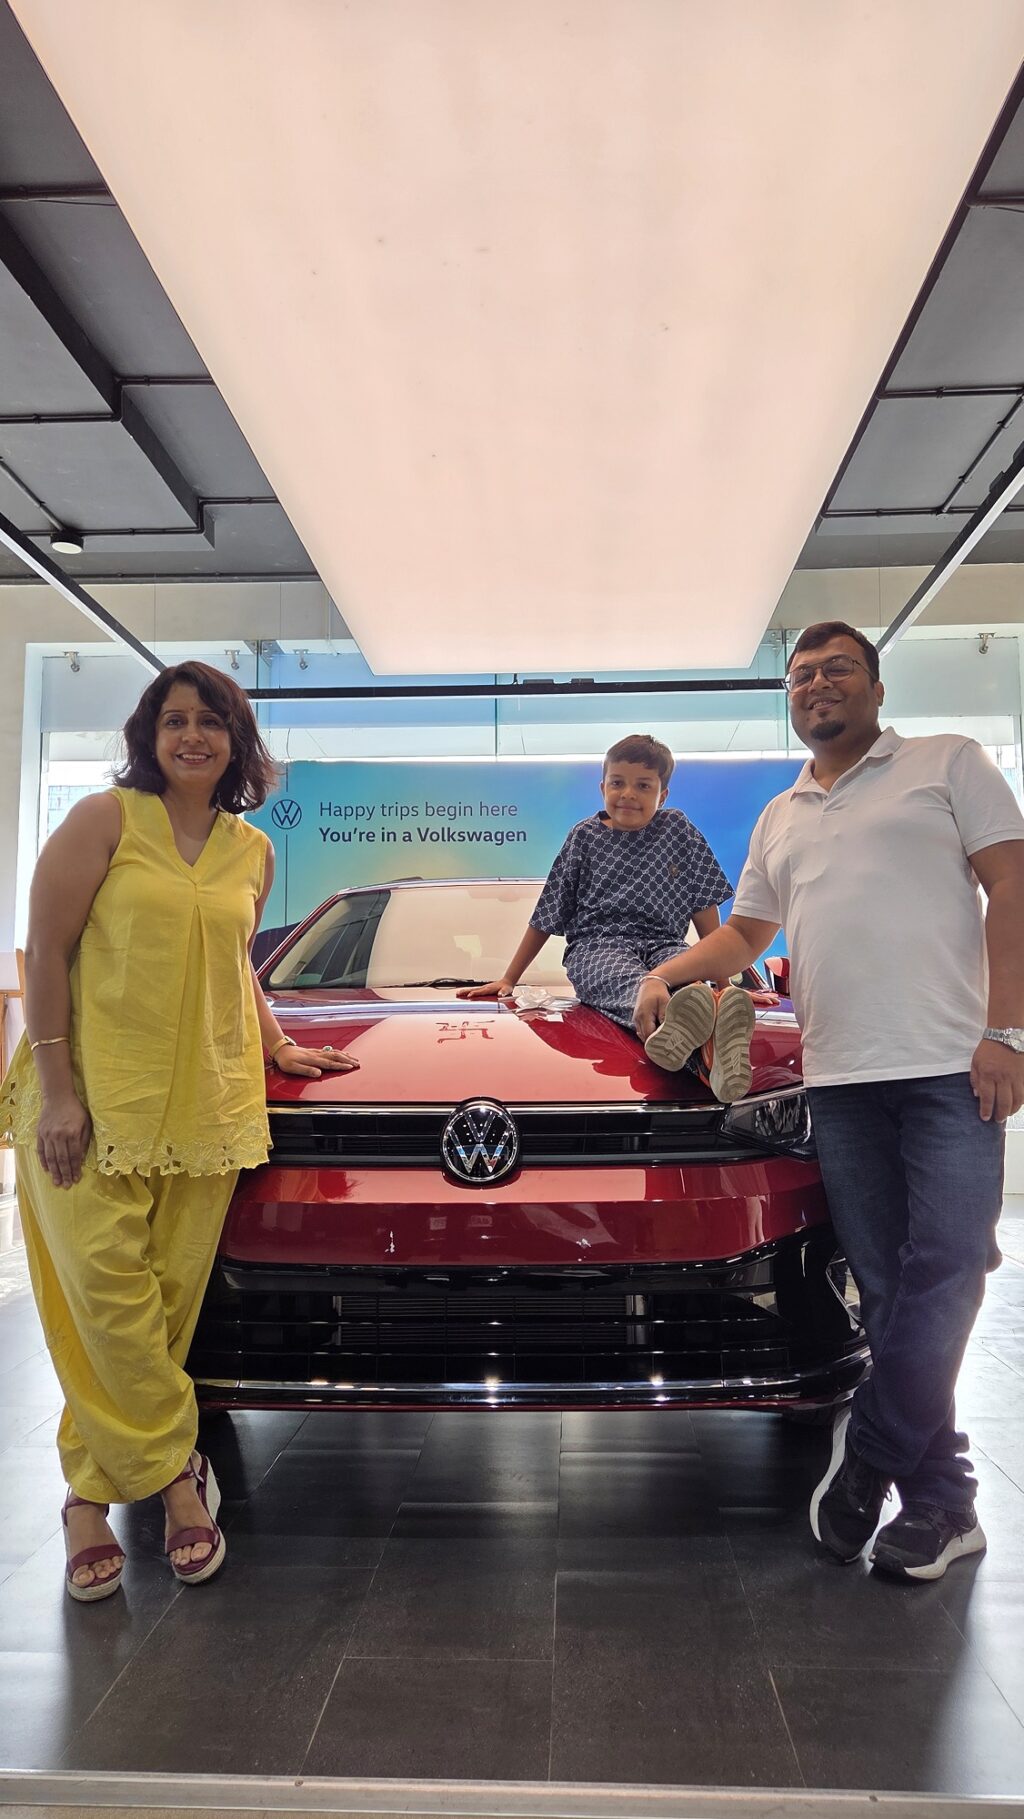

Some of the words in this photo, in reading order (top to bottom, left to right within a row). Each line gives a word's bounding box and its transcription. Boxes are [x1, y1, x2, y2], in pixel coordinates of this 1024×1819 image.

[272, 799, 301, 829] VW
[319, 801, 375, 820] Happy
[380, 801, 419, 820] trips
[425, 801, 473, 820] begin
[479, 801, 518, 817] here
[319, 827, 376, 842] You're
[381, 827, 397, 842] in
[402, 829, 413, 842] a
[417, 827, 527, 846] Volkswagen
[445, 1106, 516, 1176] VW
